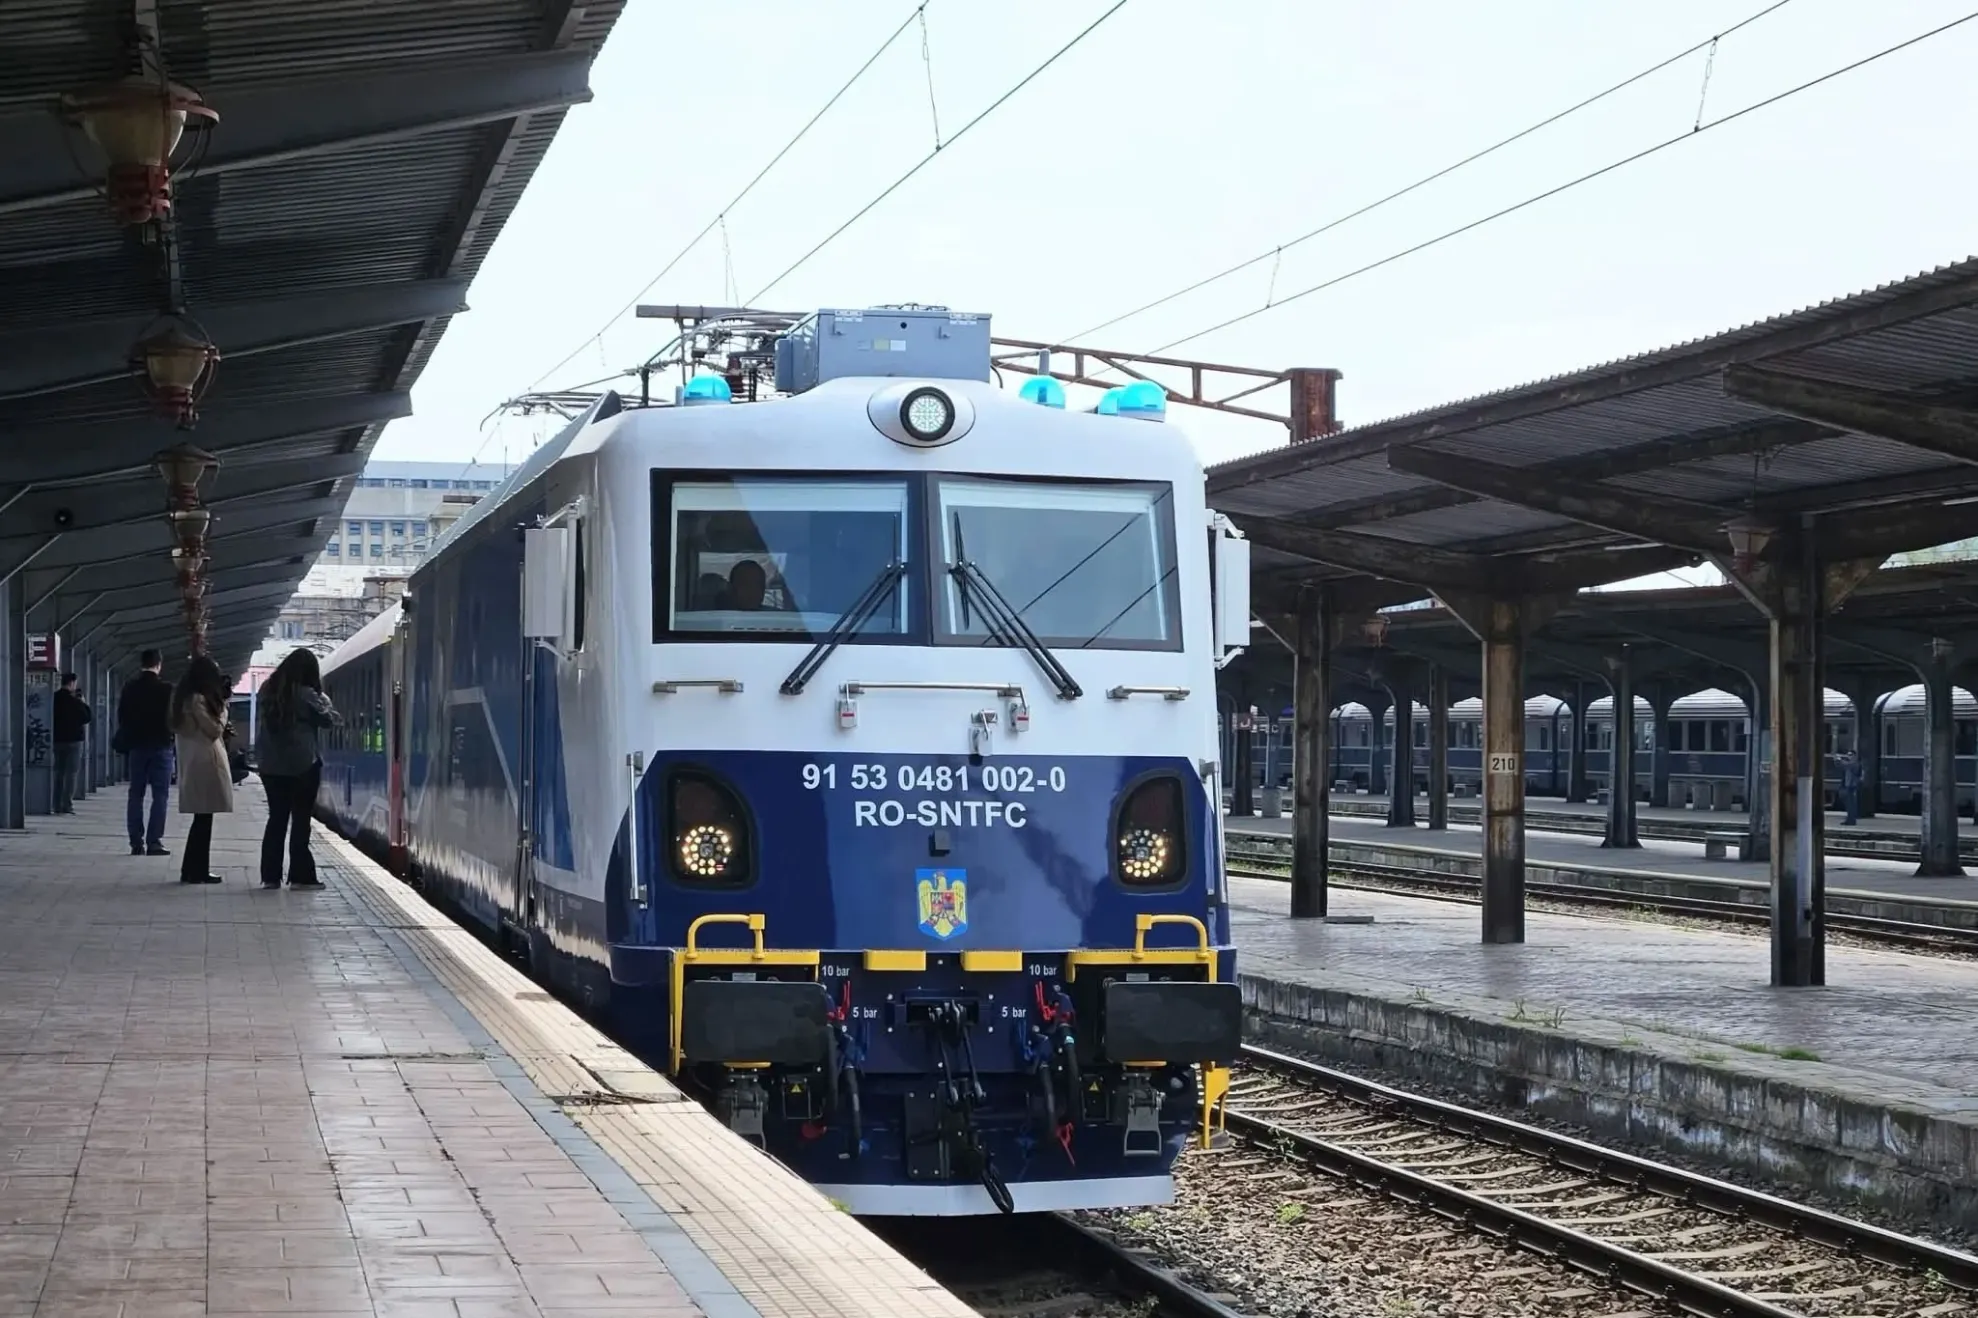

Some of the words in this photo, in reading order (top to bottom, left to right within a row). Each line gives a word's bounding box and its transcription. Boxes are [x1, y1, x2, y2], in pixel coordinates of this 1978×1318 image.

[28, 637, 47, 661] E
[1493, 757, 1515, 770] 210
[802, 763, 836, 789] 91
[850, 764, 887, 790] 53
[897, 765, 969, 792] 0481
[982, 766, 1066, 792] 002-0
[855, 800, 1027, 828] RO-SNTFC
[821, 966, 834, 976] 10
[836, 966, 851, 976] bar
[1029, 965, 1041, 975] 10
[1043, 965, 1057, 975] bar
[852, 1007, 859, 1018] 5
[863, 1007, 878, 1018] bar
[1001, 1007, 1009, 1018] 5
[1012, 1007, 1027, 1018] bar
